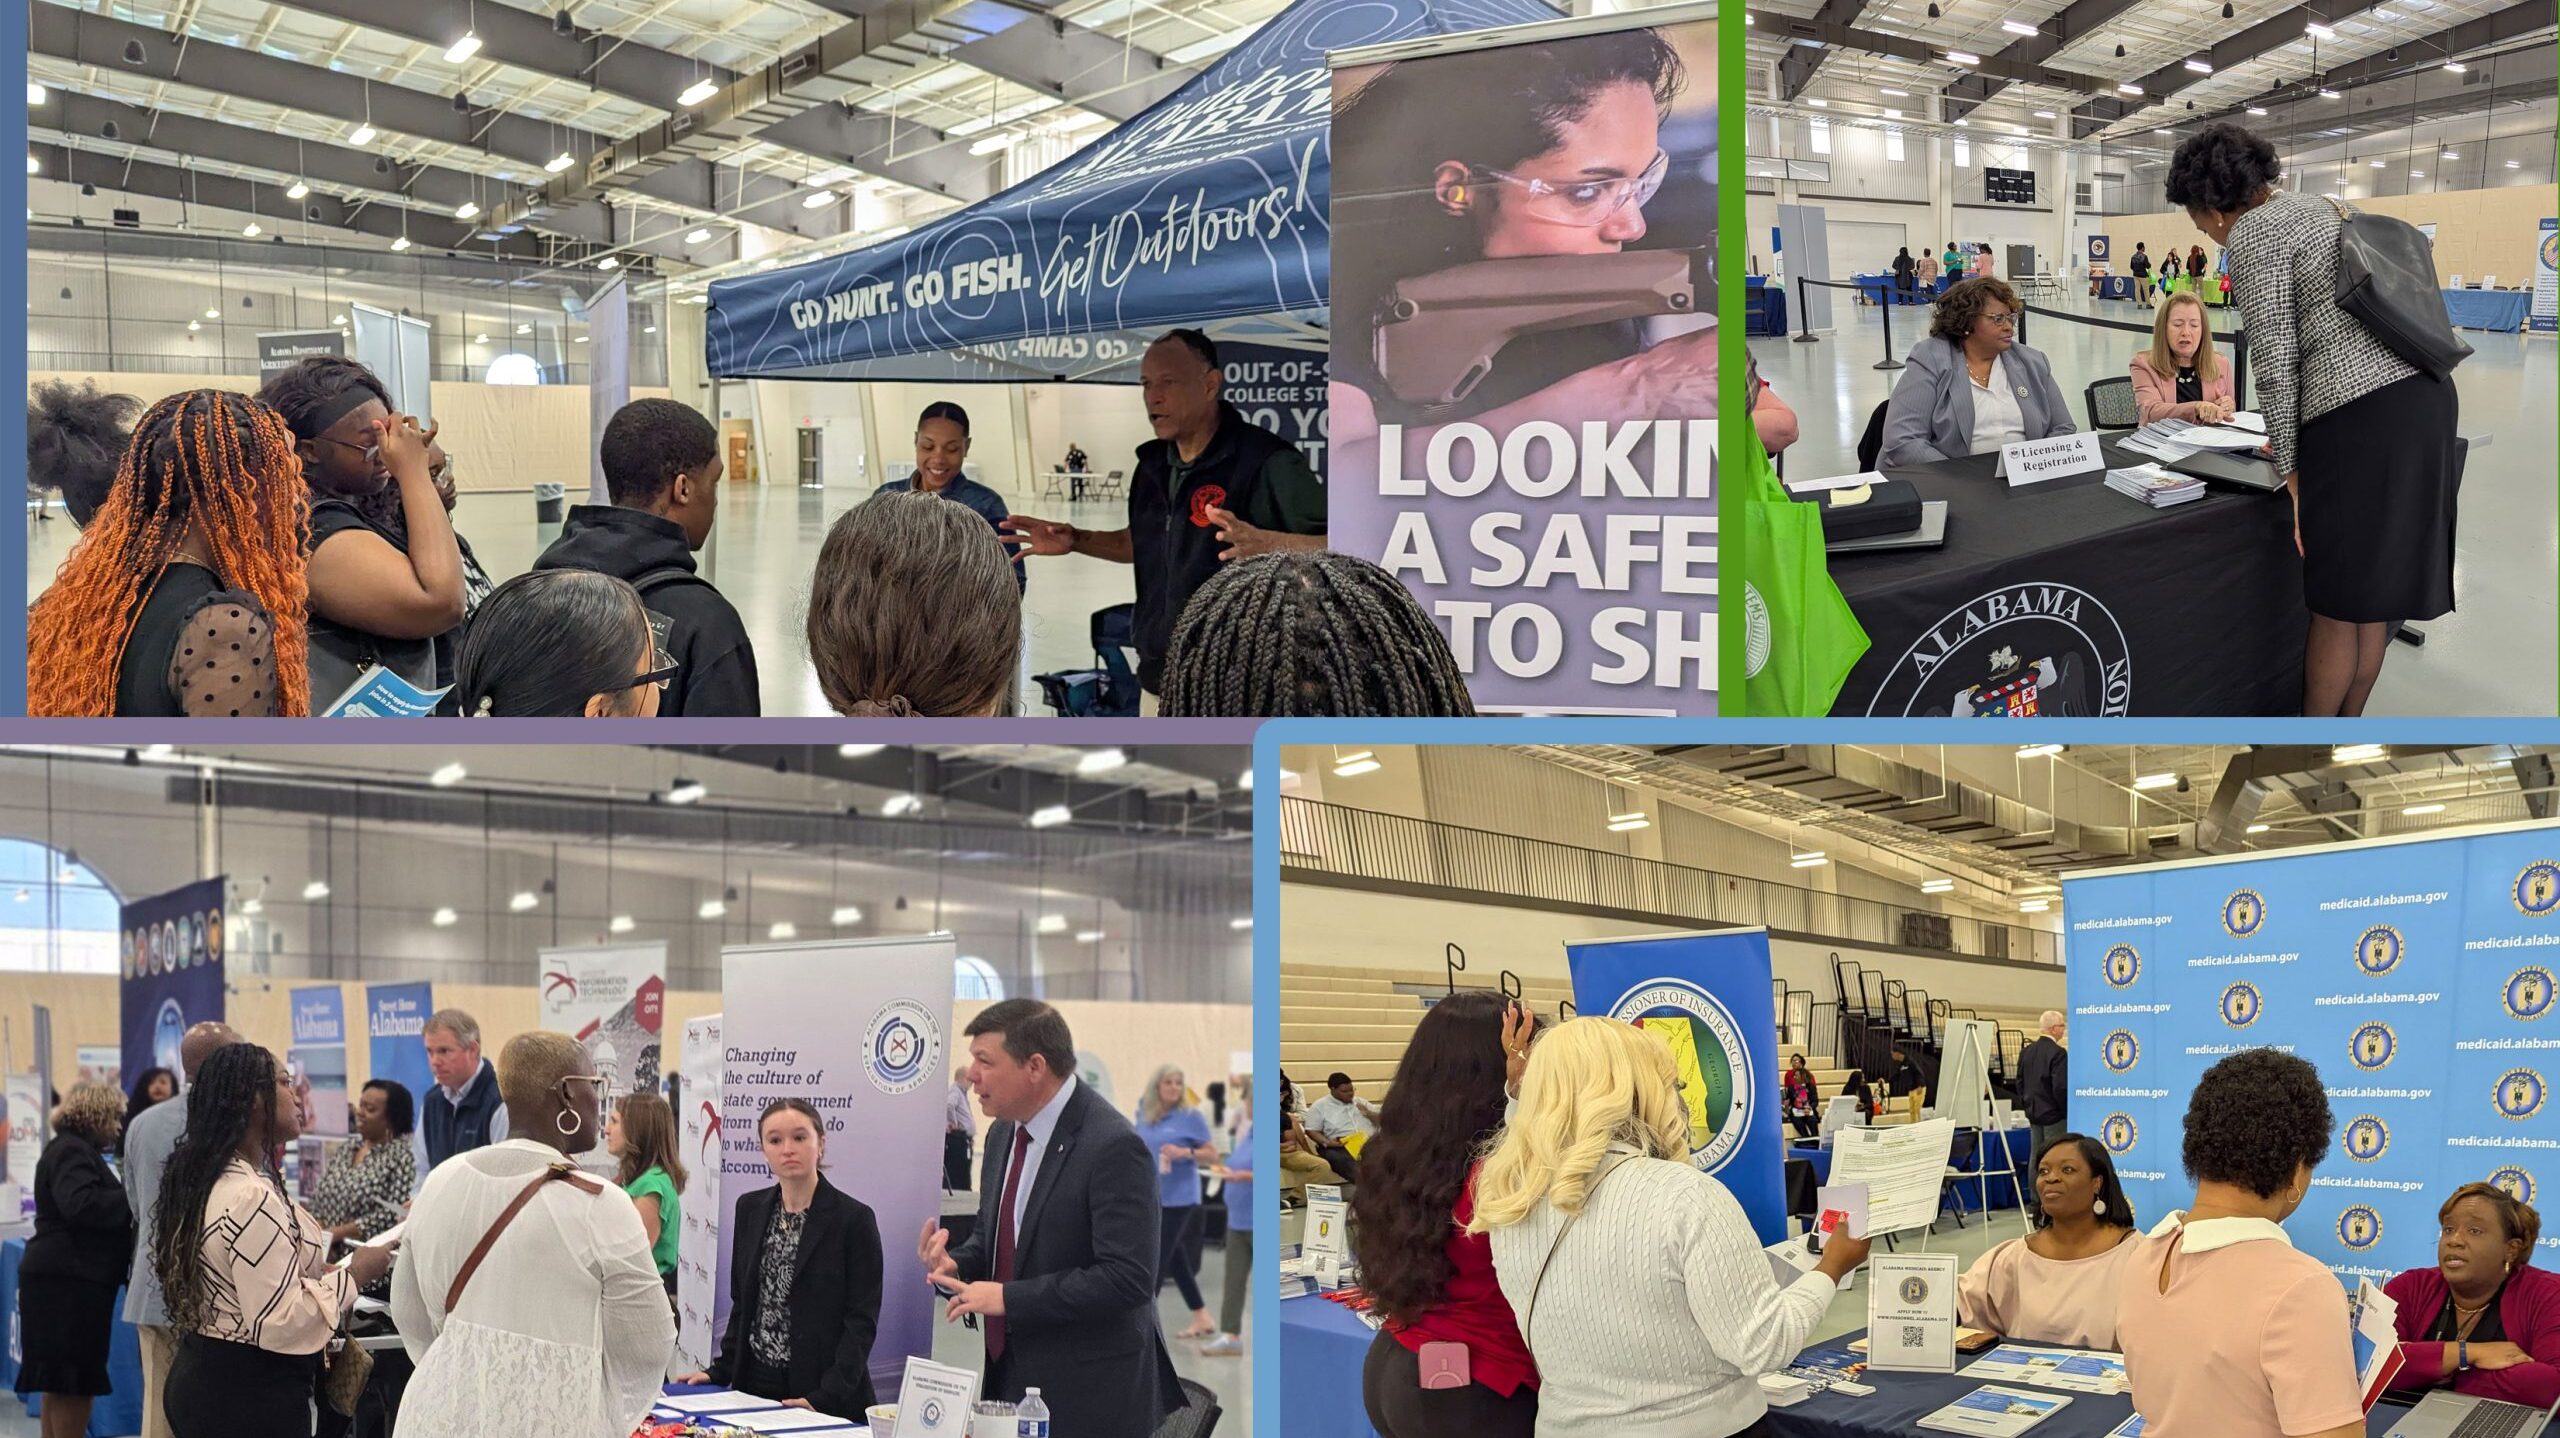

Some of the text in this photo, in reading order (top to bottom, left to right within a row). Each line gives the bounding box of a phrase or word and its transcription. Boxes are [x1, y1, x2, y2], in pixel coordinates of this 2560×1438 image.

[790, 300, 823, 330] GO
[826, 281, 898, 325] HUNT.
[905, 270, 944, 309] GO
[951, 253, 1031, 300] FISH.
[1039, 223, 1103, 315] Get
[1224, 387, 1299, 403] COLLEGE
[2021, 440, 2083, 457] Licensing &
[2023, 454, 2087, 471] Registration
[1379, 511, 1718, 595] A SAFE
[1912, 587, 2081, 679] ALABAMA
[1434, 600, 1718, 691] TO SH
[2319, 891, 2448, 911] medicaid.alabama.gov
[2074, 915, 2172, 931] medicaid.alabama.gov
[2188, 952, 2299, 968] medicaid.alabama.gov
[2314, 991, 2440, 1007] medicaid.alabama.gov
[2075, 1002, 2171, 1015] medicaid.alabama.gov
[371, 1011, 424, 1036] Alabama
[1669, 991, 1686, 1004] OF
[1688, 997, 1743, 1073] INSURANCE
[725, 1047, 797, 1066] Changing
[724, 1070, 823, 1085] the culture of
[1708, 1052, 1723, 1096] GEORGIA
[723, 1094, 754, 1107] state
[2075, 1087, 2169, 1099] medicaid.alabama.gov
[2323, 1087, 2432, 1100] dicaid.alabama.gov
[722, 1115, 844, 1131] from do
[722, 1137, 764, 1151] to wha
